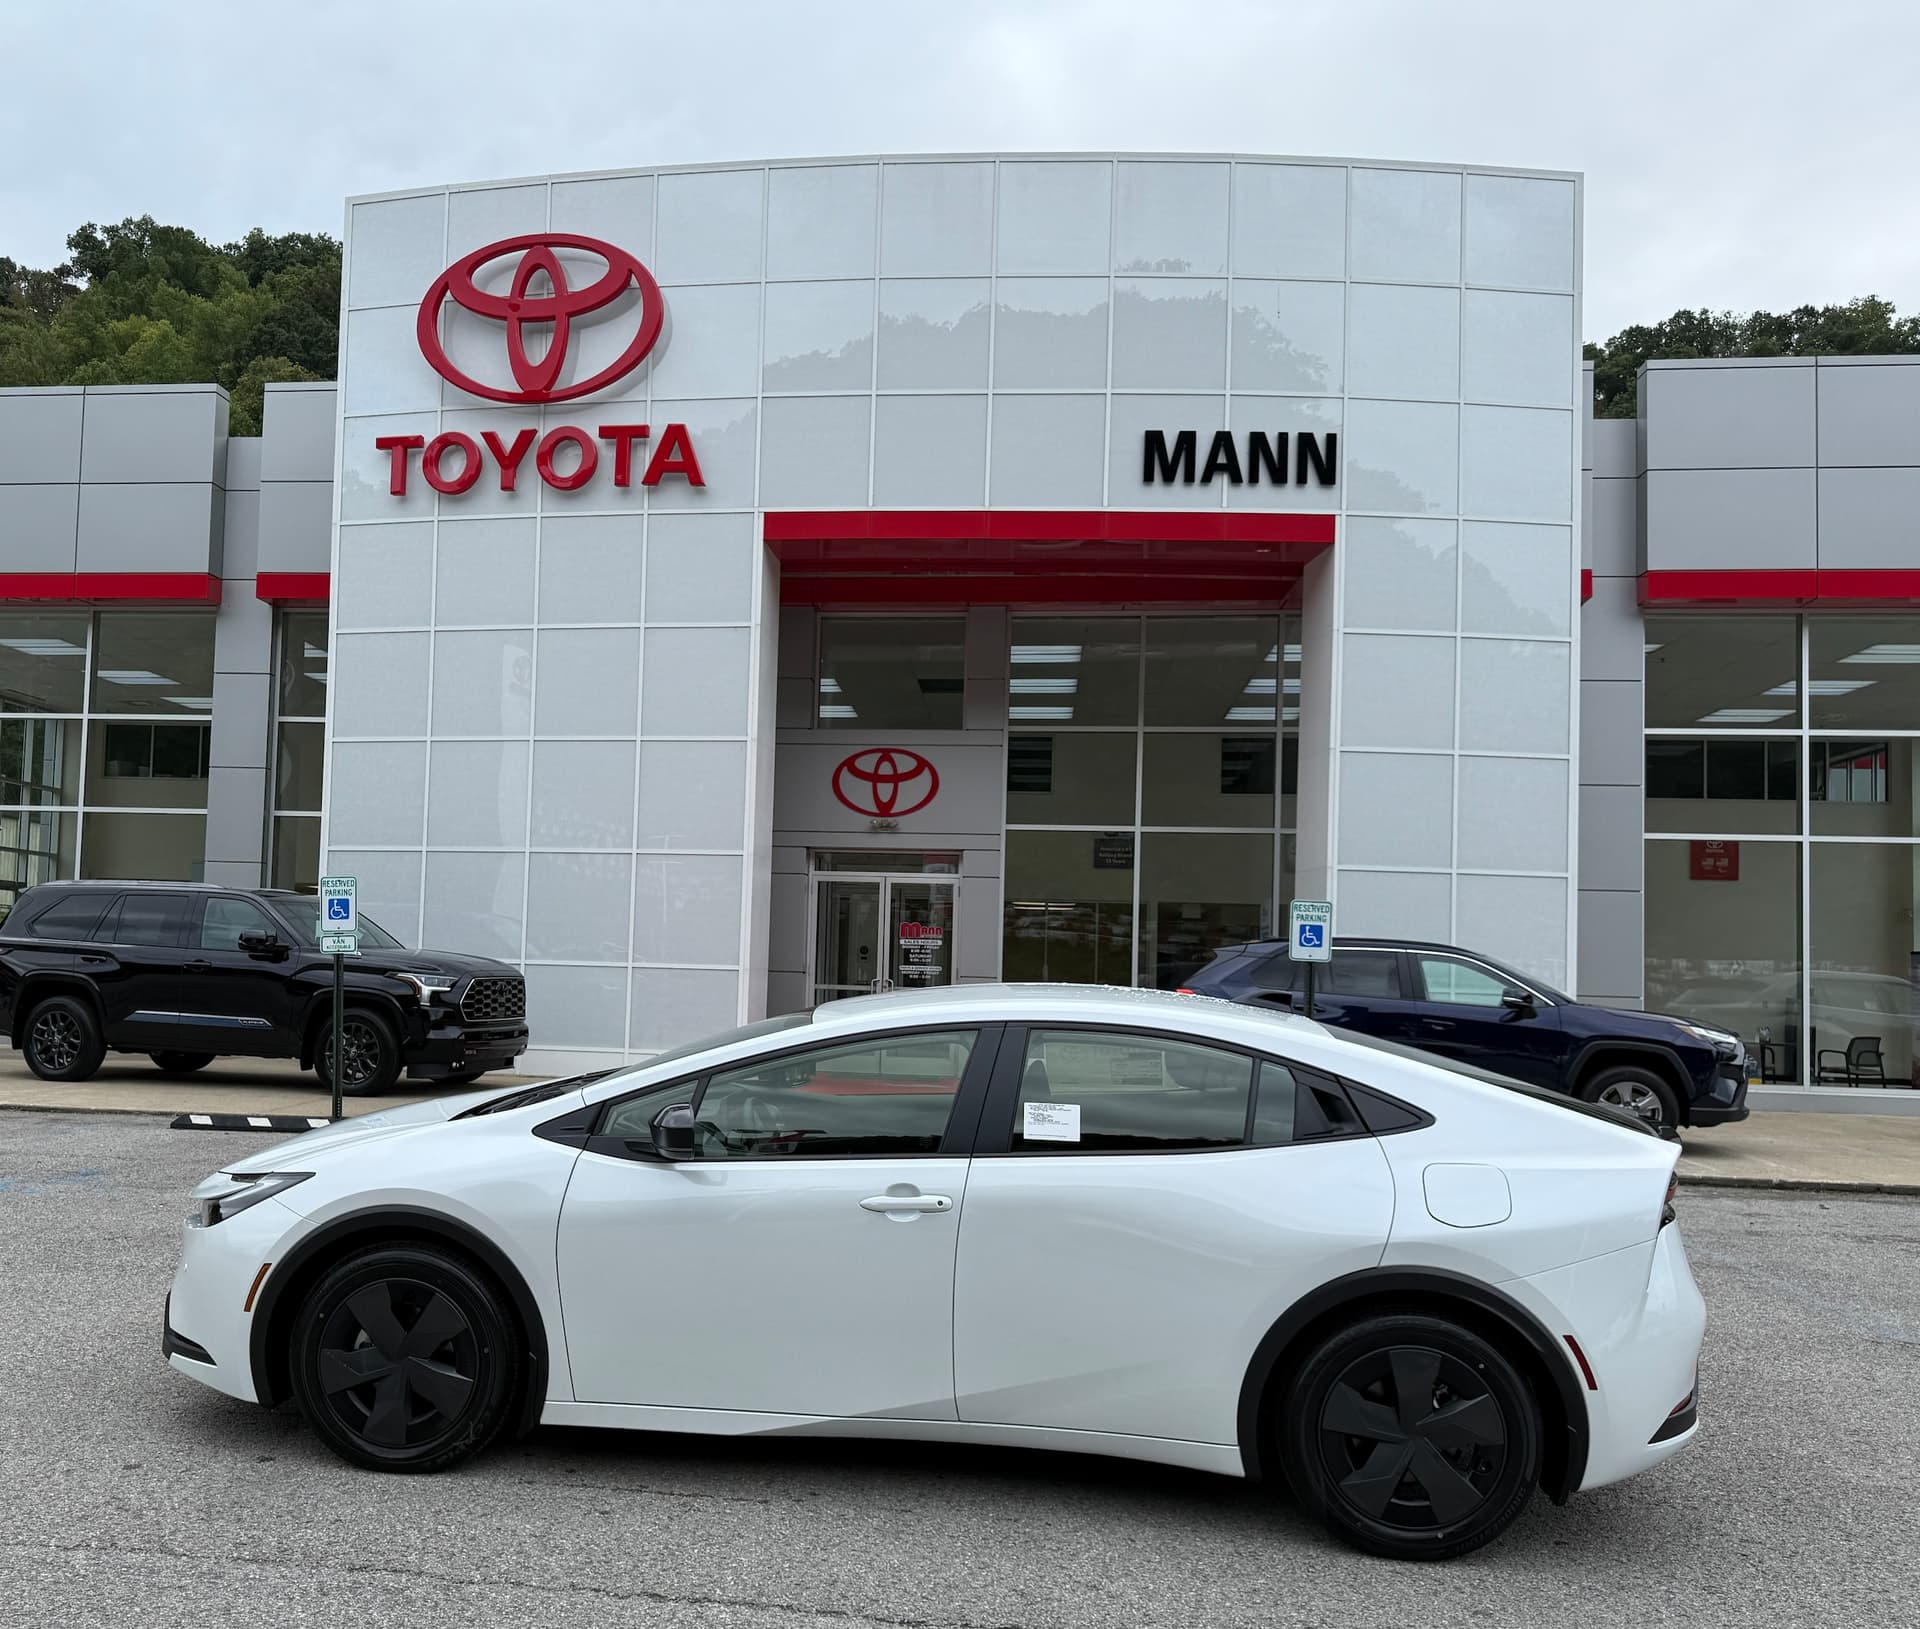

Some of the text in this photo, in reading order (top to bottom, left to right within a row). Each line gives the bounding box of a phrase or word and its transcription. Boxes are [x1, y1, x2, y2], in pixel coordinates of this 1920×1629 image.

[376, 423, 706, 497] TOYOTA
[1143, 430, 1337, 485] MANN
[322, 880, 355, 888] RESERVED
[1293, 904, 1330, 913] RESERVED
[1296, 913, 1327, 923] PARKING
